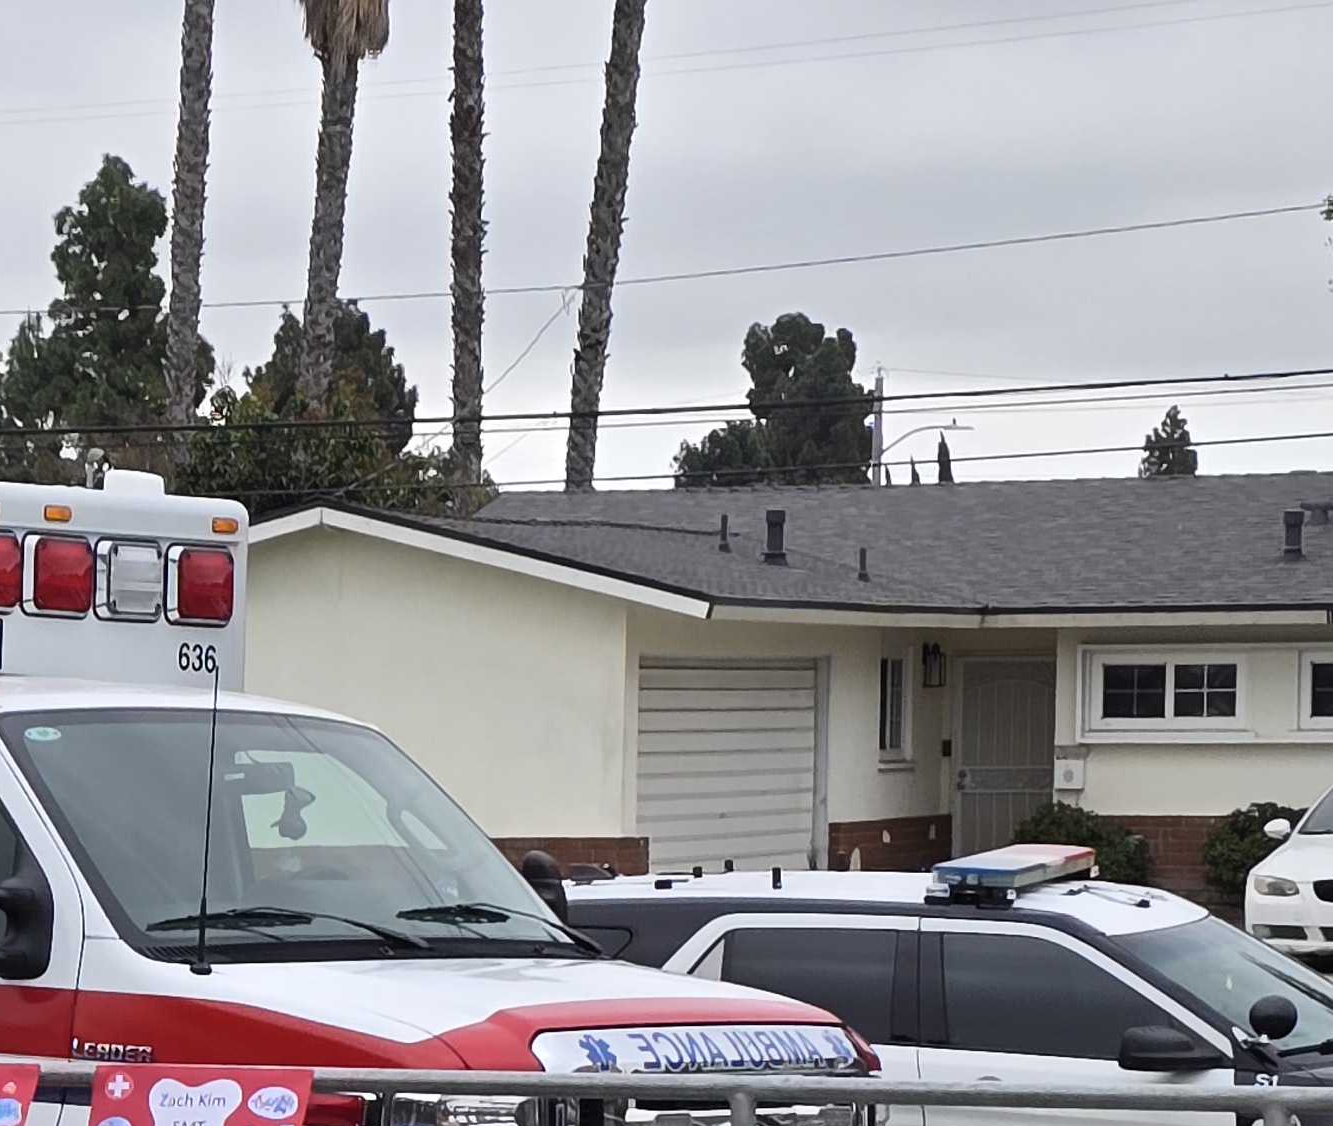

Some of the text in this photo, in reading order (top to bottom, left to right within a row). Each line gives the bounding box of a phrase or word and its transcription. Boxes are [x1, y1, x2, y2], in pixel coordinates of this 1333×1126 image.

[178, 642, 217, 674] 636
[159, 1093, 226, 1108] Zach Kim
